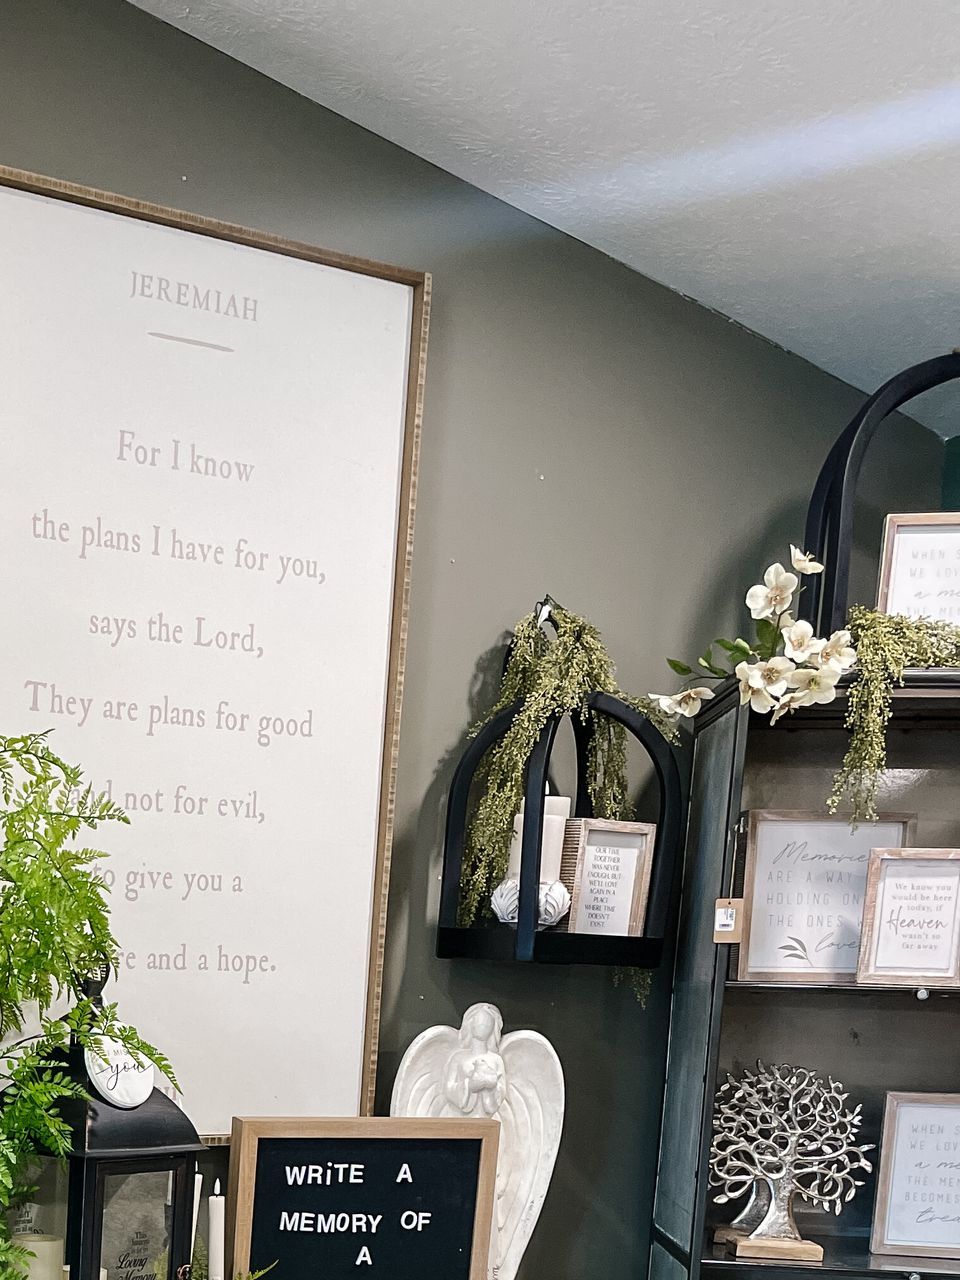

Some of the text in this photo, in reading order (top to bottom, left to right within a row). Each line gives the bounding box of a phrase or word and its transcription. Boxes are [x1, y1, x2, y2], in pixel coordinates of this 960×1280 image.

[129, 271, 259, 323] JEREMIAH
[116, 430, 256, 483] For I know
[32, 509, 327, 585] the plans I have for you,
[88, 612, 265, 658] says the Lord,
[24, 679, 314, 747] They are plans for good
[123, 784, 267, 824] not for evil,
[125, 861, 244, 902] give you a
[767, 870, 852, 883] ARE WAY
[766, 893, 831, 905] HOLDING
[768, 914, 843, 927] THE ONES
[886, 906, 948, 935] Heaven
[146, 943, 188, 972] and
[198, 952, 209, 972] a
[217, 945, 277, 984] hope.
[912, 1124, 944, 1134] WHEN
[910, 1140, 924, 1150] WE
[395, 1163, 413, 1184] A
[907, 1176, 928, 1186] THE
[279, 1210, 432, 1234] MEMORY OF
[115, 1253, 148, 1272] Loving
[355, 1245, 373, 1266] A
